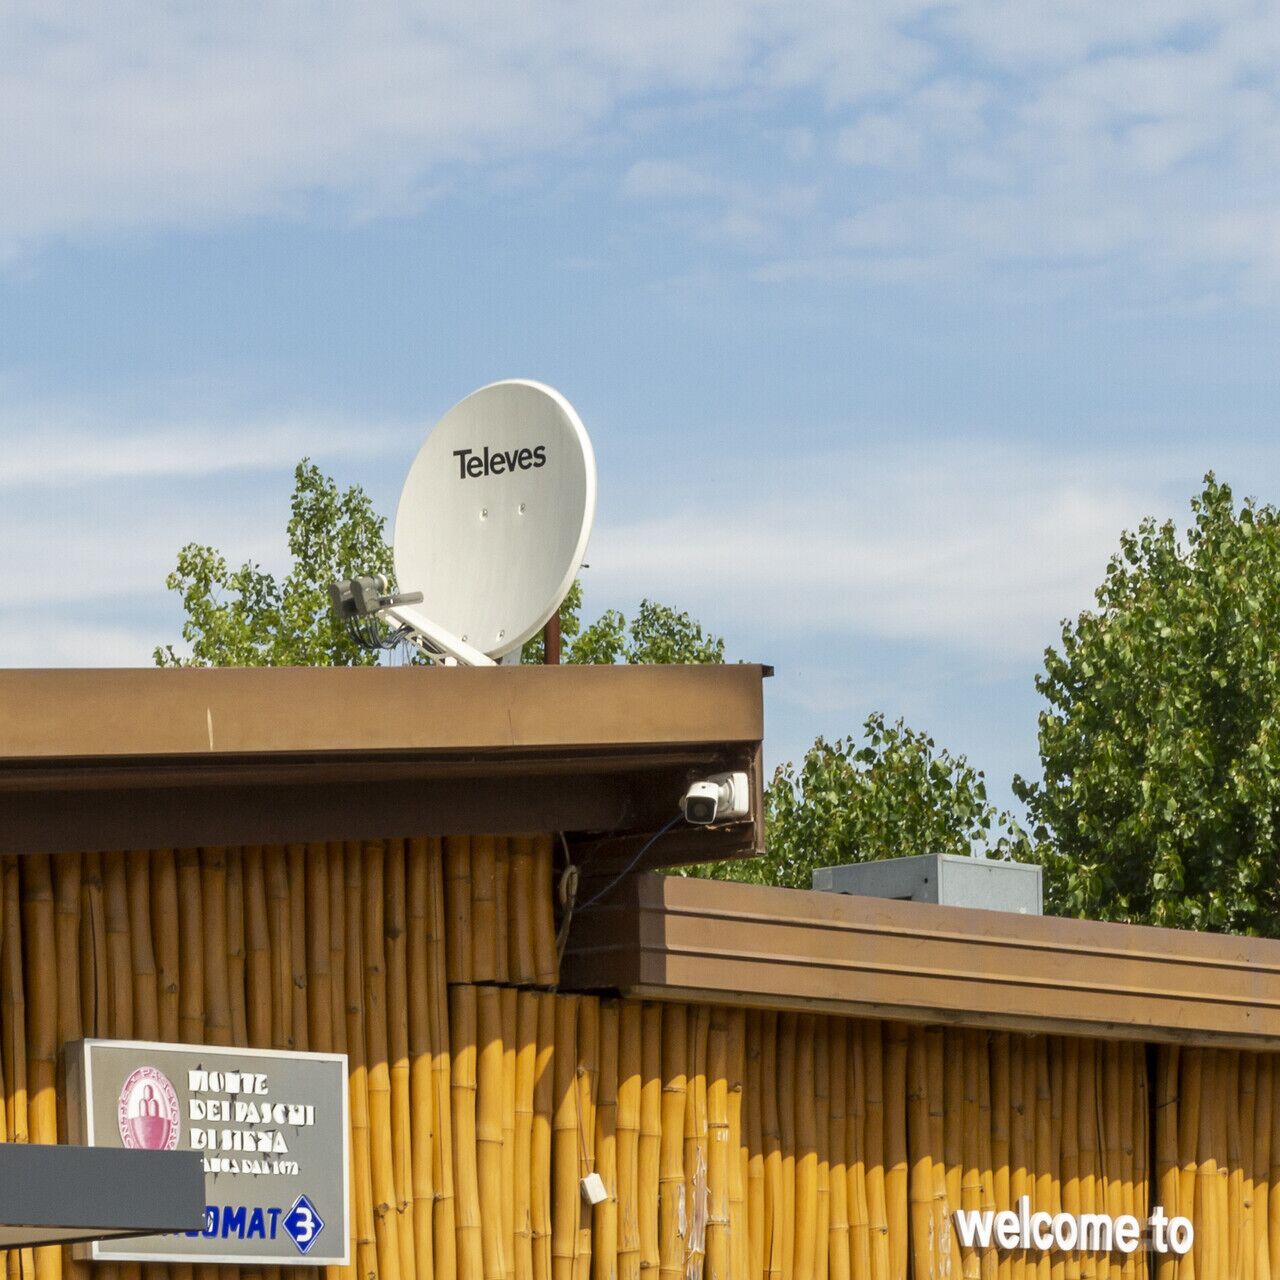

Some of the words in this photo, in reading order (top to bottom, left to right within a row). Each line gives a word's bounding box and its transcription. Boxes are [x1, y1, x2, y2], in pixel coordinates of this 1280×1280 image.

[453, 445, 547, 479] Televes
[189, 1099, 231, 1122] DEI
[234, 1101, 315, 1126] PASCHI
[190, 1127, 217, 1150] DI
[954, 1195, 1140, 1253] welcome
[1151, 1206, 1195, 1254] to
